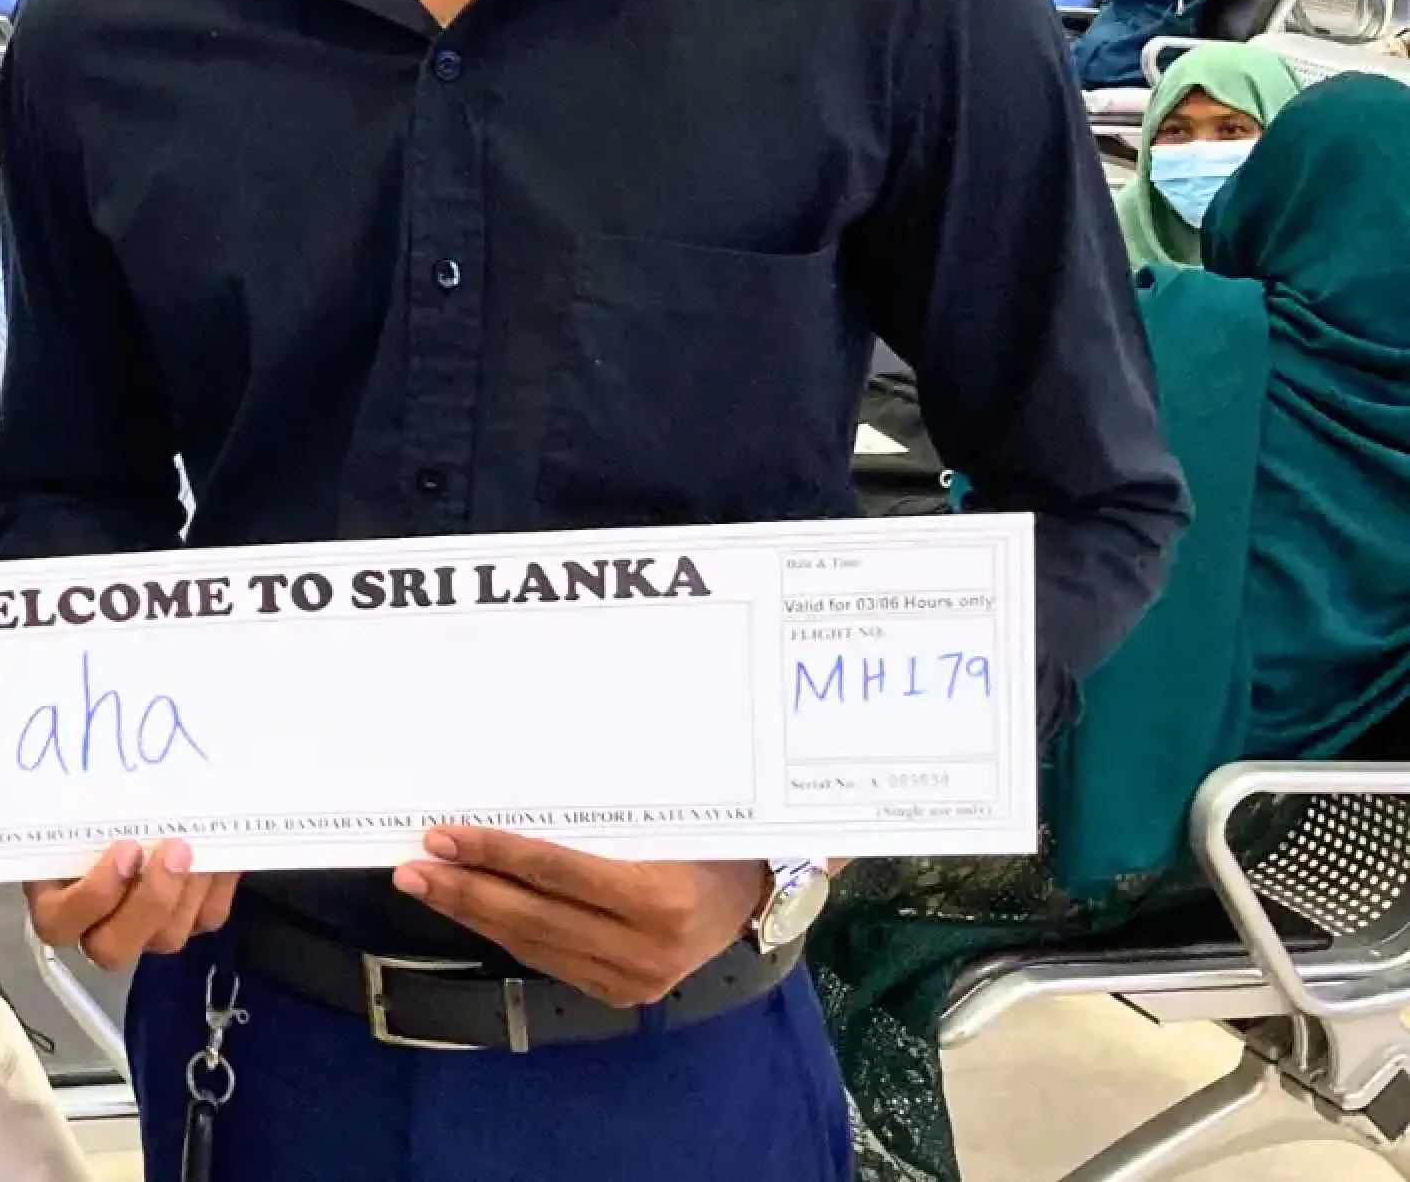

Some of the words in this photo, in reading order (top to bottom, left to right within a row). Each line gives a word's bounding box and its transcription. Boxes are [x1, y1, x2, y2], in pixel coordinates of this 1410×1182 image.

[248, 572, 333, 613] TO
[351, 565, 457, 610] SRI
[474, 555, 711, 605] LANKA
[784, 598, 824, 612] Valid
[829, 597, 851, 611] for
[904, 595, 953, 609] Hours
[958, 593, 995, 611] only
[791, 627, 852, 641] FLIGHT
[28, 827, 104, 842] SERVICES
[421, 812, 553, 828] INTERNATIONAL
[643, 807, 754, 822] KATUNAYAKE
